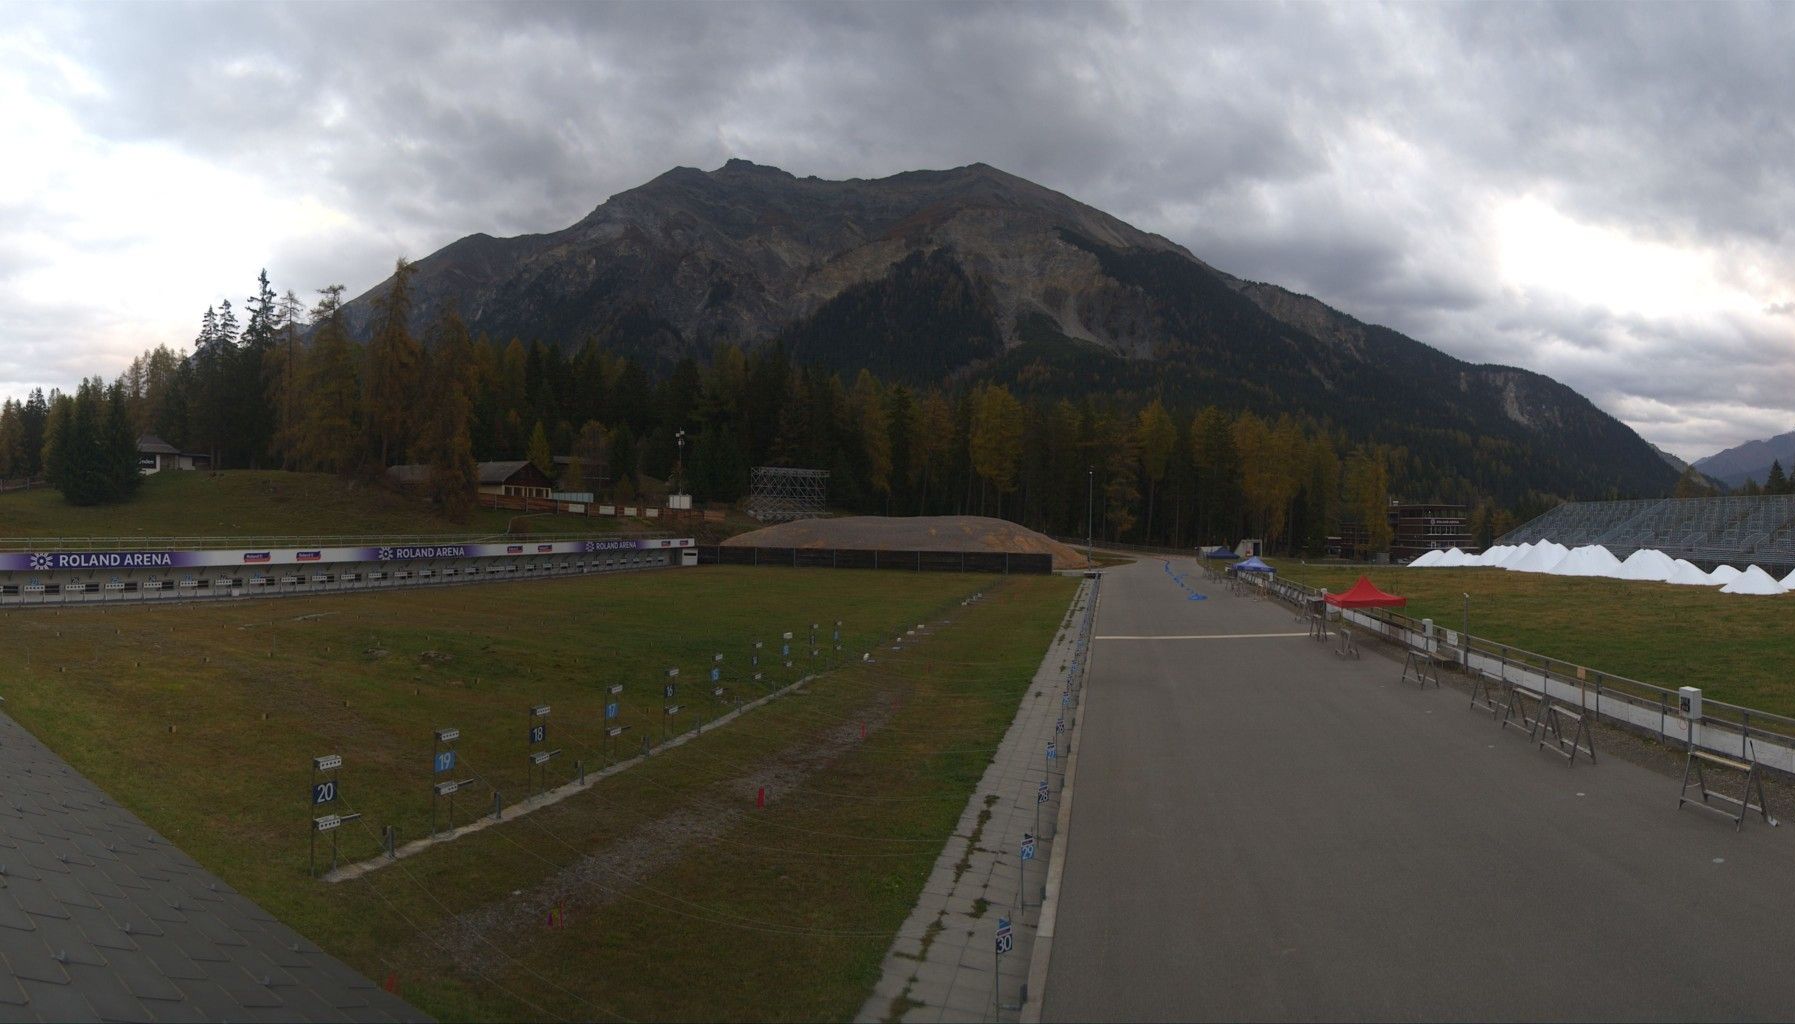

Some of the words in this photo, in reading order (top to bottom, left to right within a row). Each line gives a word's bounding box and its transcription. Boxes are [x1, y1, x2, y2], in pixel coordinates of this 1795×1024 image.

[396, 548, 434, 559] ROLAND
[436, 547, 465, 557] ARENA
[596, 542, 617, 551] ROLAND
[619, 541, 637, 550] ARENA
[59, 555, 120, 567] ROLAND
[124, 554, 171, 566] ARENA
[608, 703, 616, 717] 17
[532, 727, 543, 741] 18
[438, 753, 451, 770] 19
[317, 783, 334, 802] 20
[1039, 790, 1048, 803] 28
[1022, 845, 1034, 860] 29
[997, 935, 1012, 954] 30
